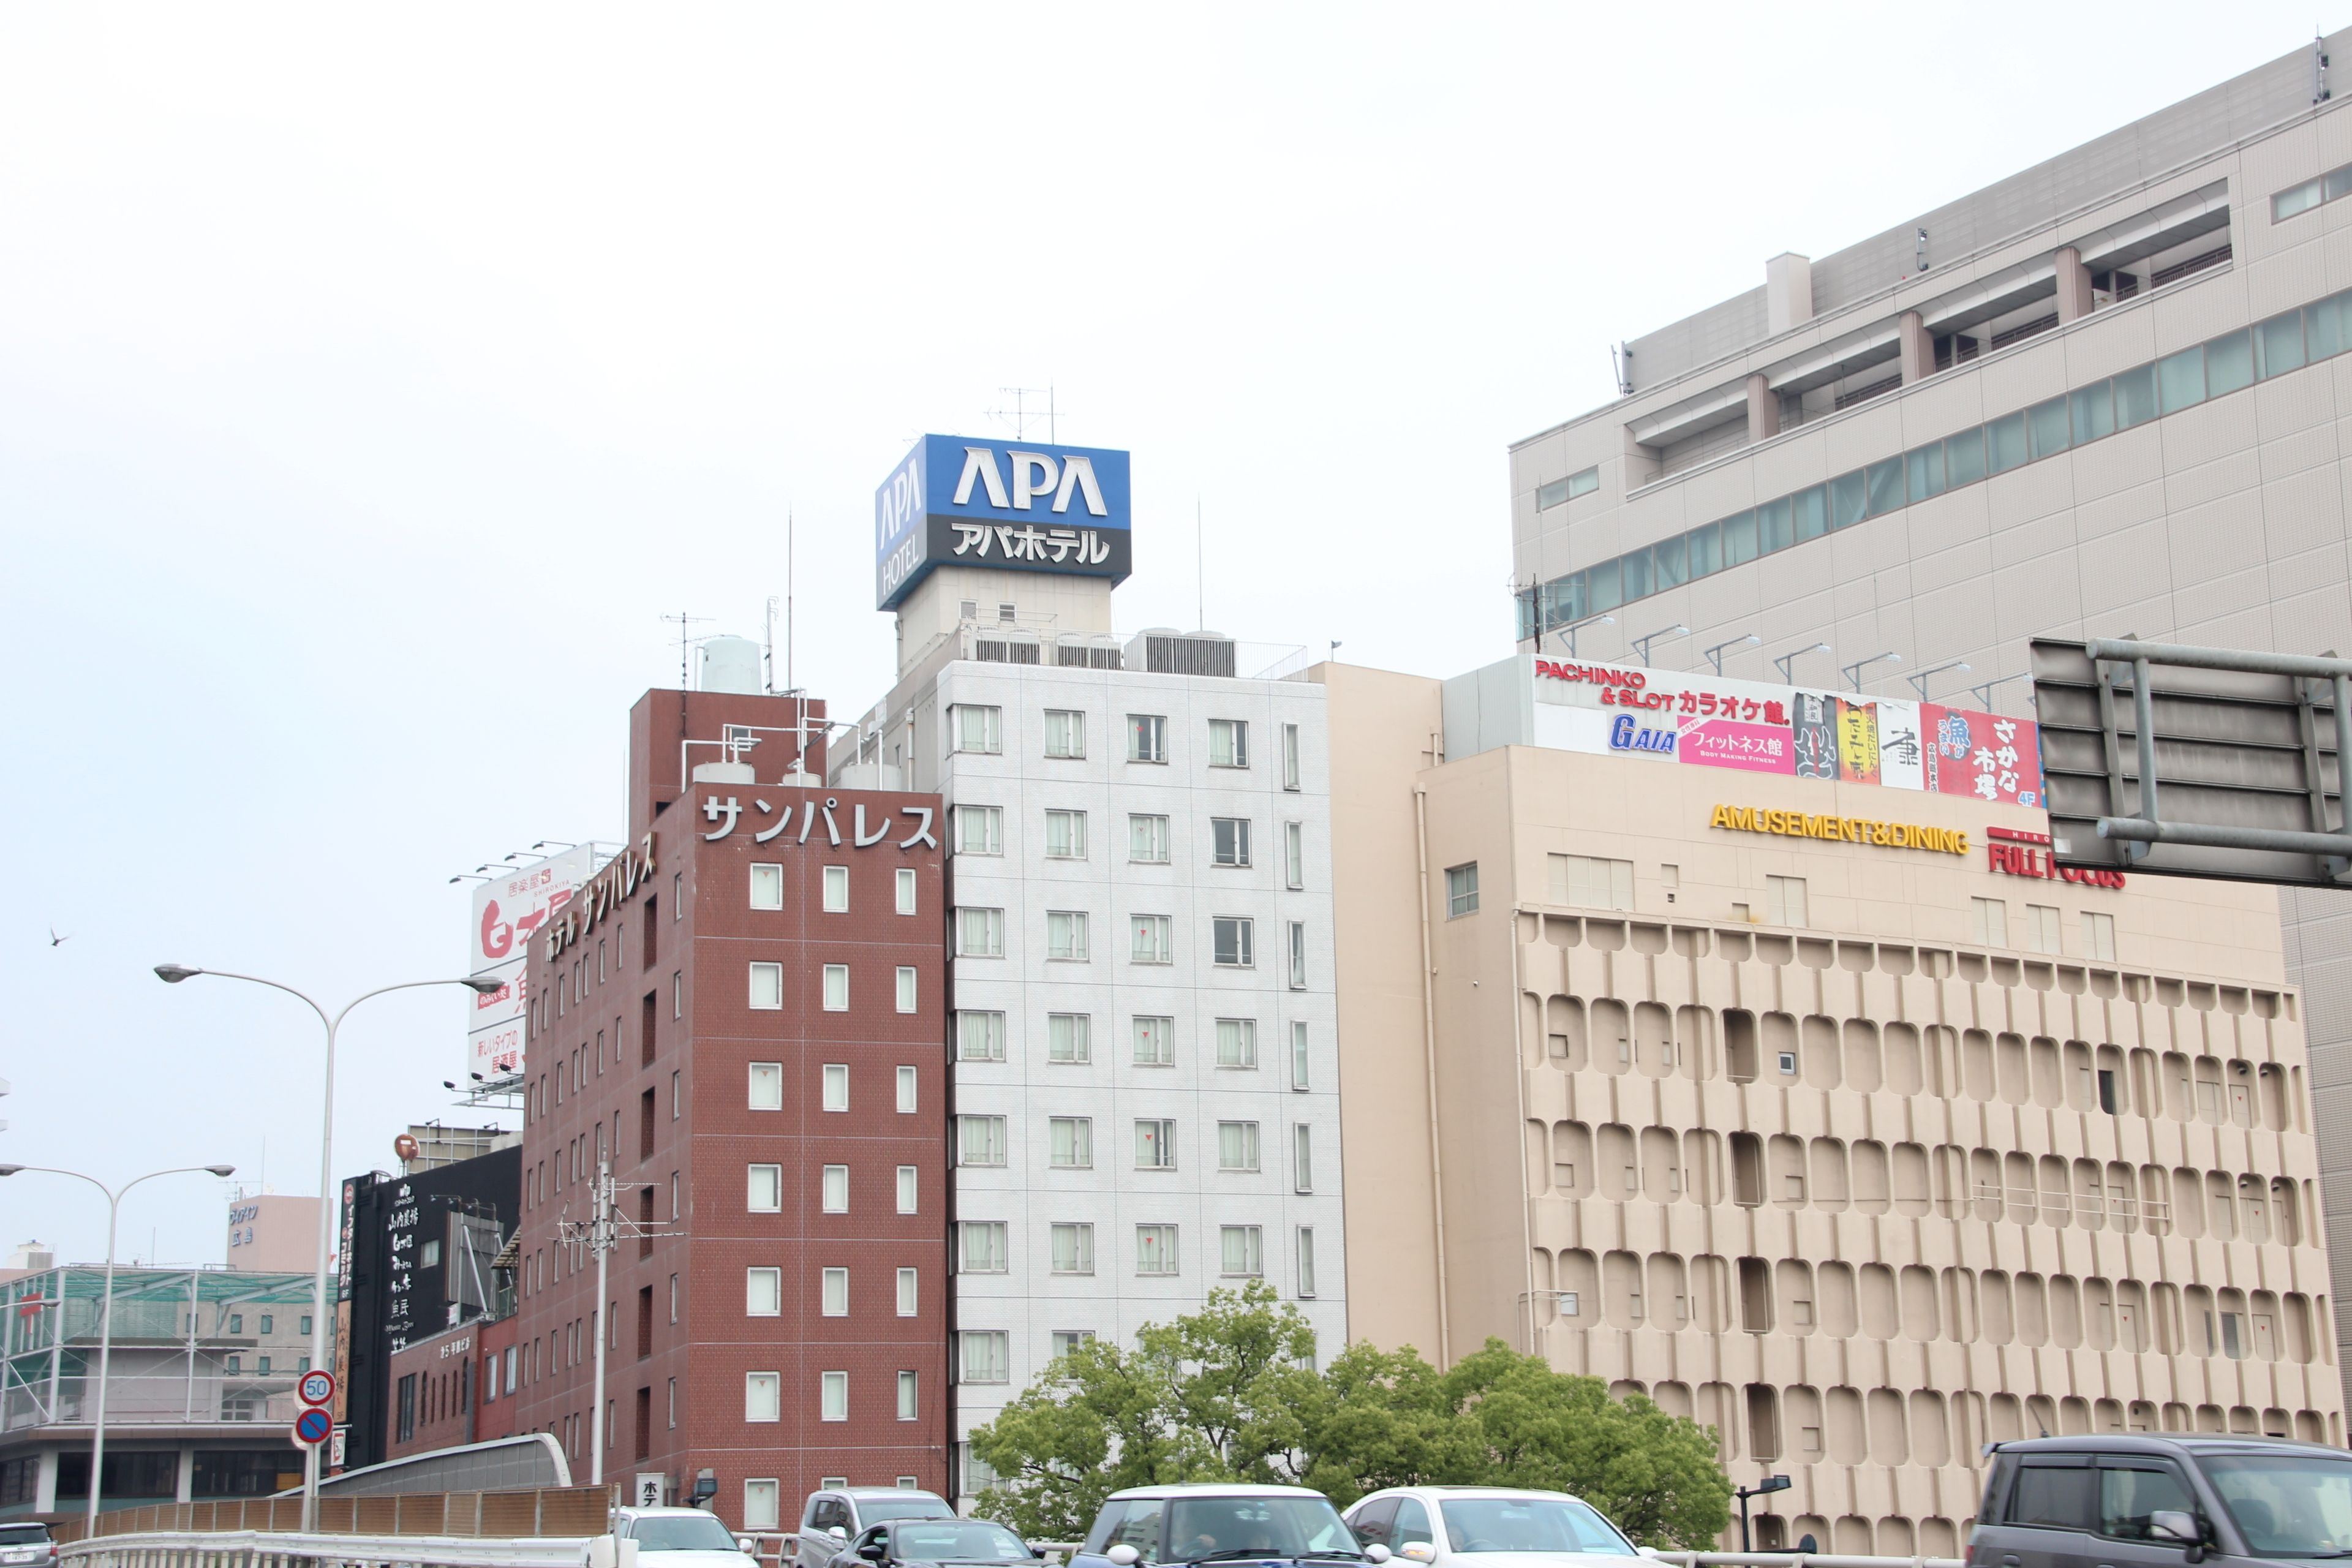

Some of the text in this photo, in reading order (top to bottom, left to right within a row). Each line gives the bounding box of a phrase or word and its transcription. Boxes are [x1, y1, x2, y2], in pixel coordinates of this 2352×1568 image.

[953, 447, 1107, 516] APA
[880, 459, 922, 548] APA
[951, 522, 1110, 565] アパホテル
[883, 535, 919, 595] HOTEL
[1536, 660, 1646, 689] PACHINKO
[1600, 687, 1674, 710] & SLOT
[1609, 714, 1677, 754] GAIA
[1692, 731, 1783, 756] フィットネス館
[2018, 791, 2035, 807] 4F
[703, 796, 937, 850] サンパレス
[1988, 843, 2044, 878] FULL
[534, 880, 570, 897] SHIROKIYA
[546, 831, 657, 963] ホテル サンパレス
[478, 1030, 518, 1058] 新しいタイプの
[232, 1227, 252, 1247] 広島
[391, 1298, 410, 1319] 魚民
[306, 1380, 327, 1395] 50
